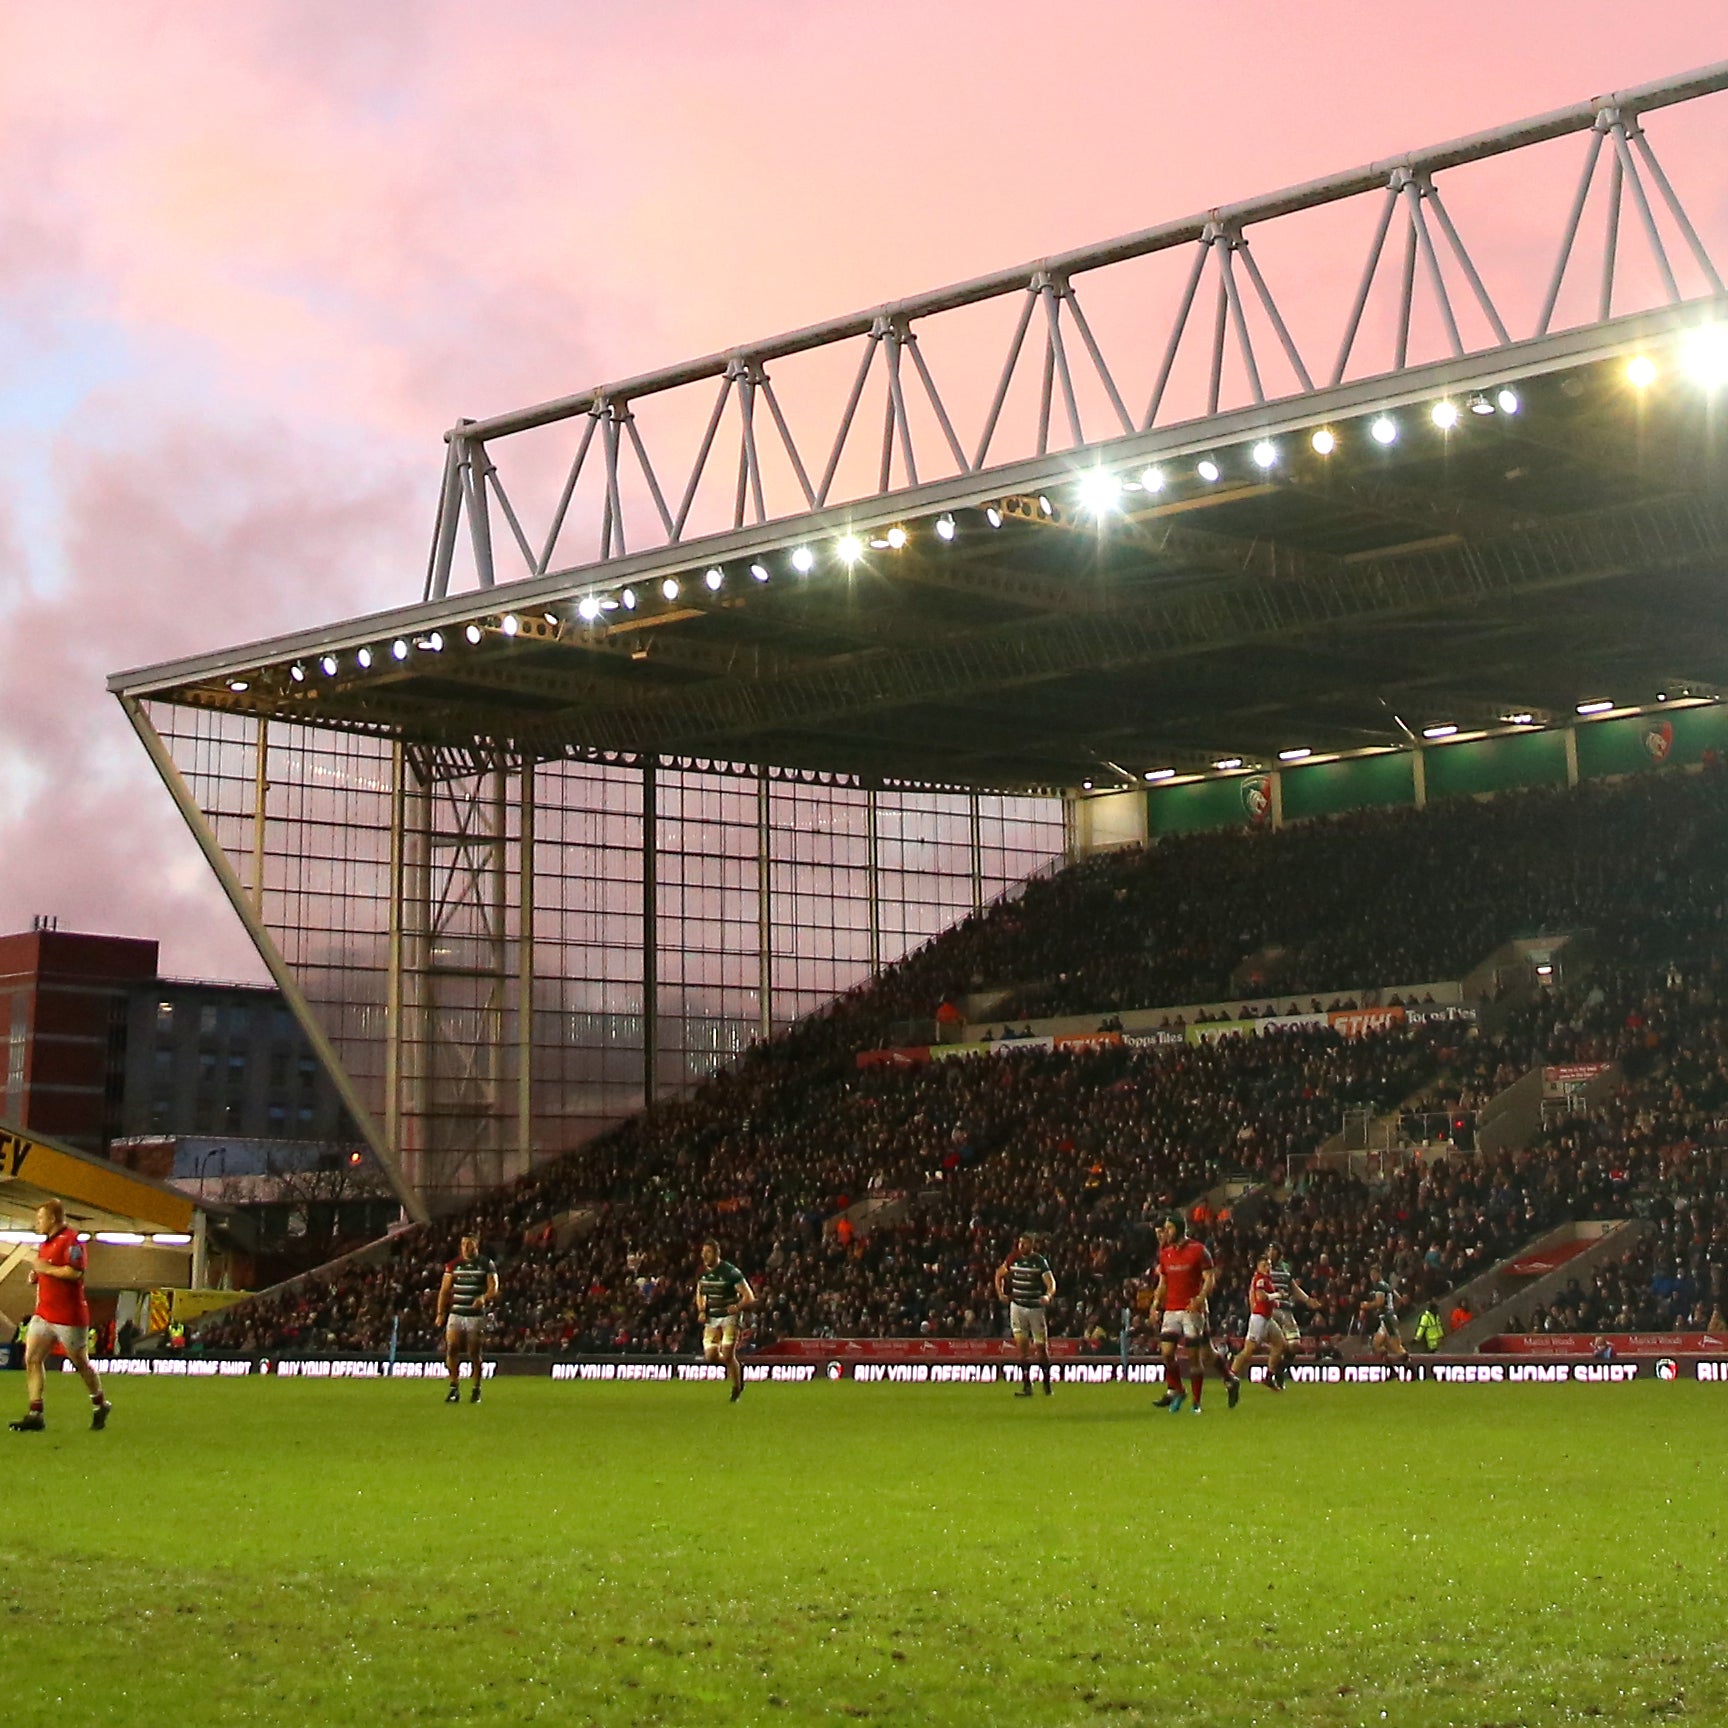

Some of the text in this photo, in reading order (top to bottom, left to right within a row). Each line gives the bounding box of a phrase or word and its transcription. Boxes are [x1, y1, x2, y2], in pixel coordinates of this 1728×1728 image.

[152, 1359, 187, 1376] TIGERS
[187, 1359, 218, 1376] HOME
[219, 1360, 252, 1377] SHIRT
[278, 1361, 300, 1377] BUY
[301, 1361, 330, 1377] YOUR
[331, 1361, 382, 1377] OFFICIAL
[382, 1361, 422, 1377] TGERS
[552, 1363, 579, 1380] BUY
[579, 1363, 616, 1380] YOUR
[677, 1364, 726, 1381] TIGERS
[771, 1365, 816, 1382] SHIRT
[854, 1365, 886, 1382] BUY
[887, 1365, 928, 1382] YOUR
[1064, 1365, 1113, 1382] HOME
